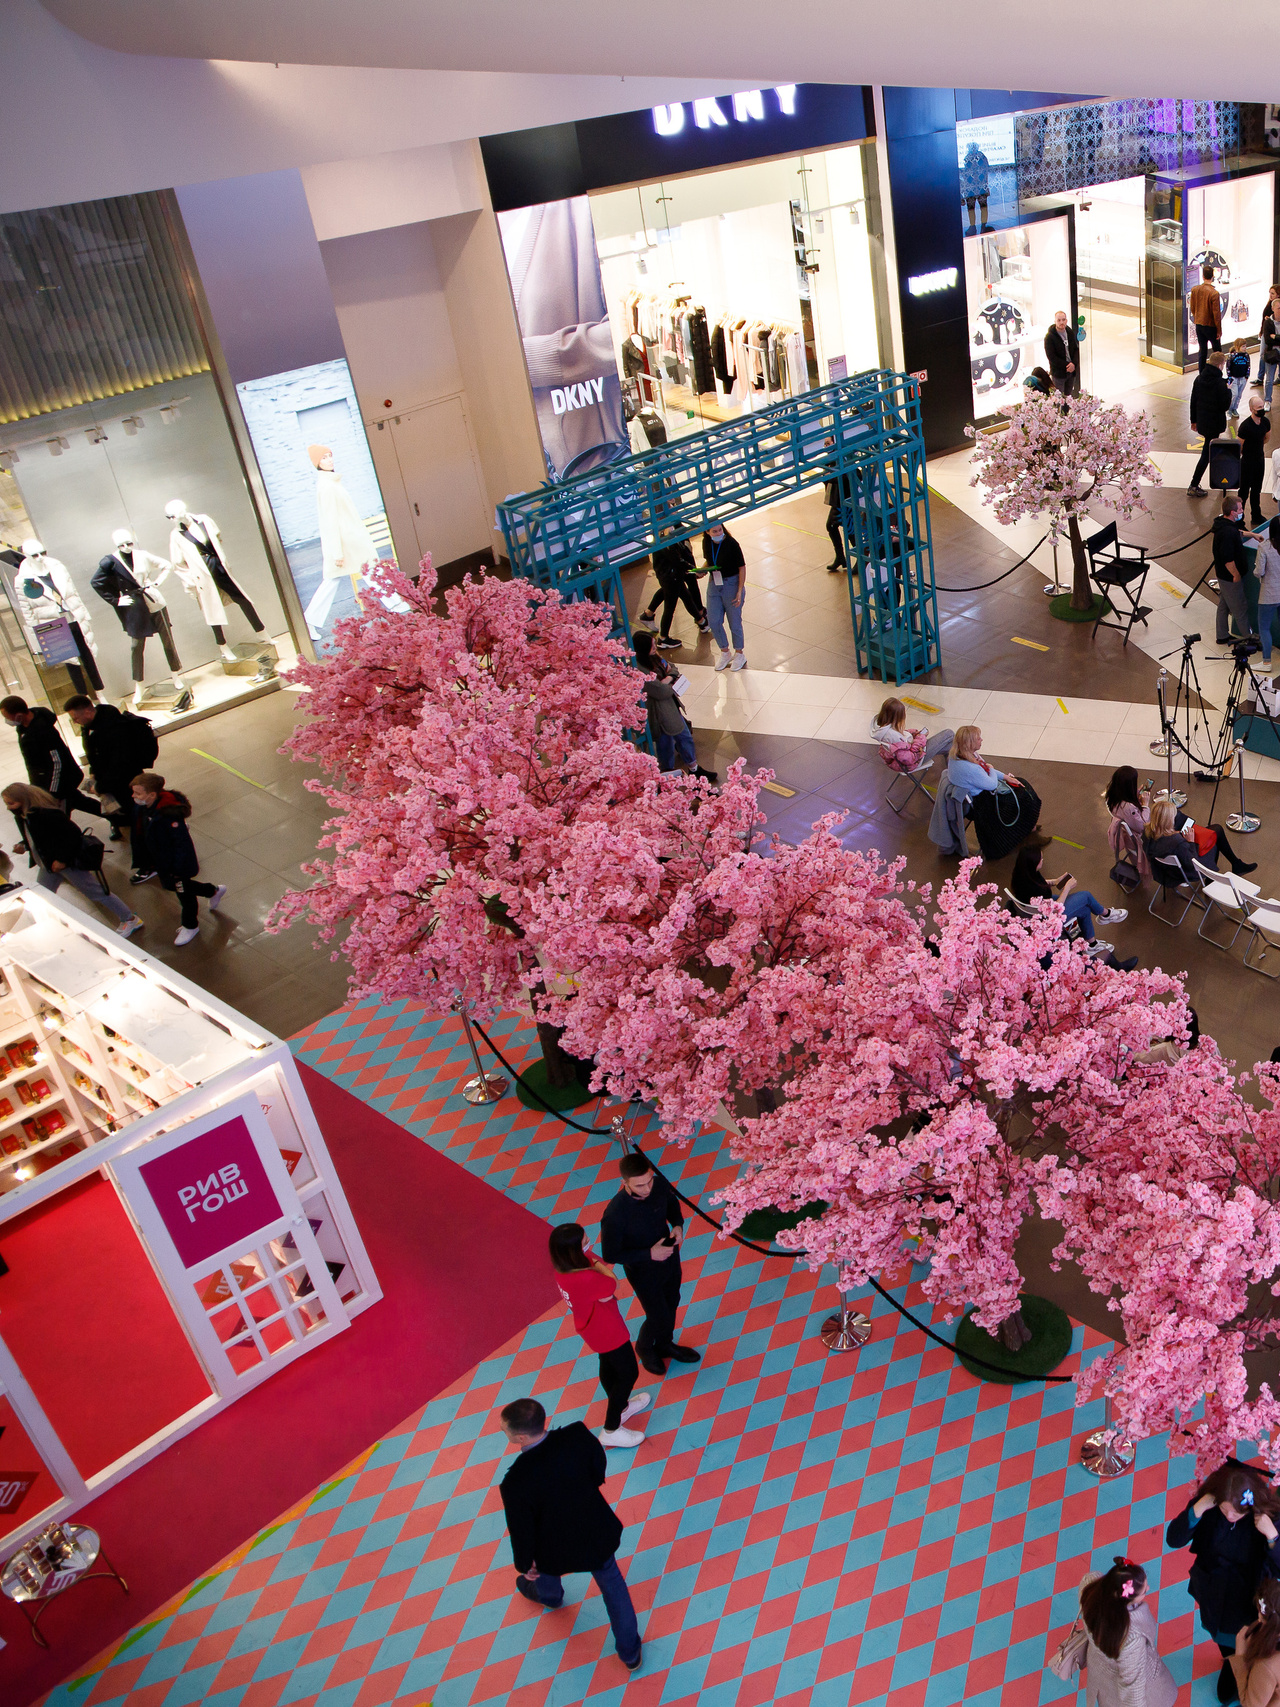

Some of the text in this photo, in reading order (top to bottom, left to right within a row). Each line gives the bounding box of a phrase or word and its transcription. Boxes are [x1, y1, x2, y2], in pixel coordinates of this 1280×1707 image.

[652, 83, 797, 136] DKNY
[550, 376, 604, 415] DKNY
[177, 1163, 241, 1206] РИВ
[185, 1179, 249, 1223] ГОШ
